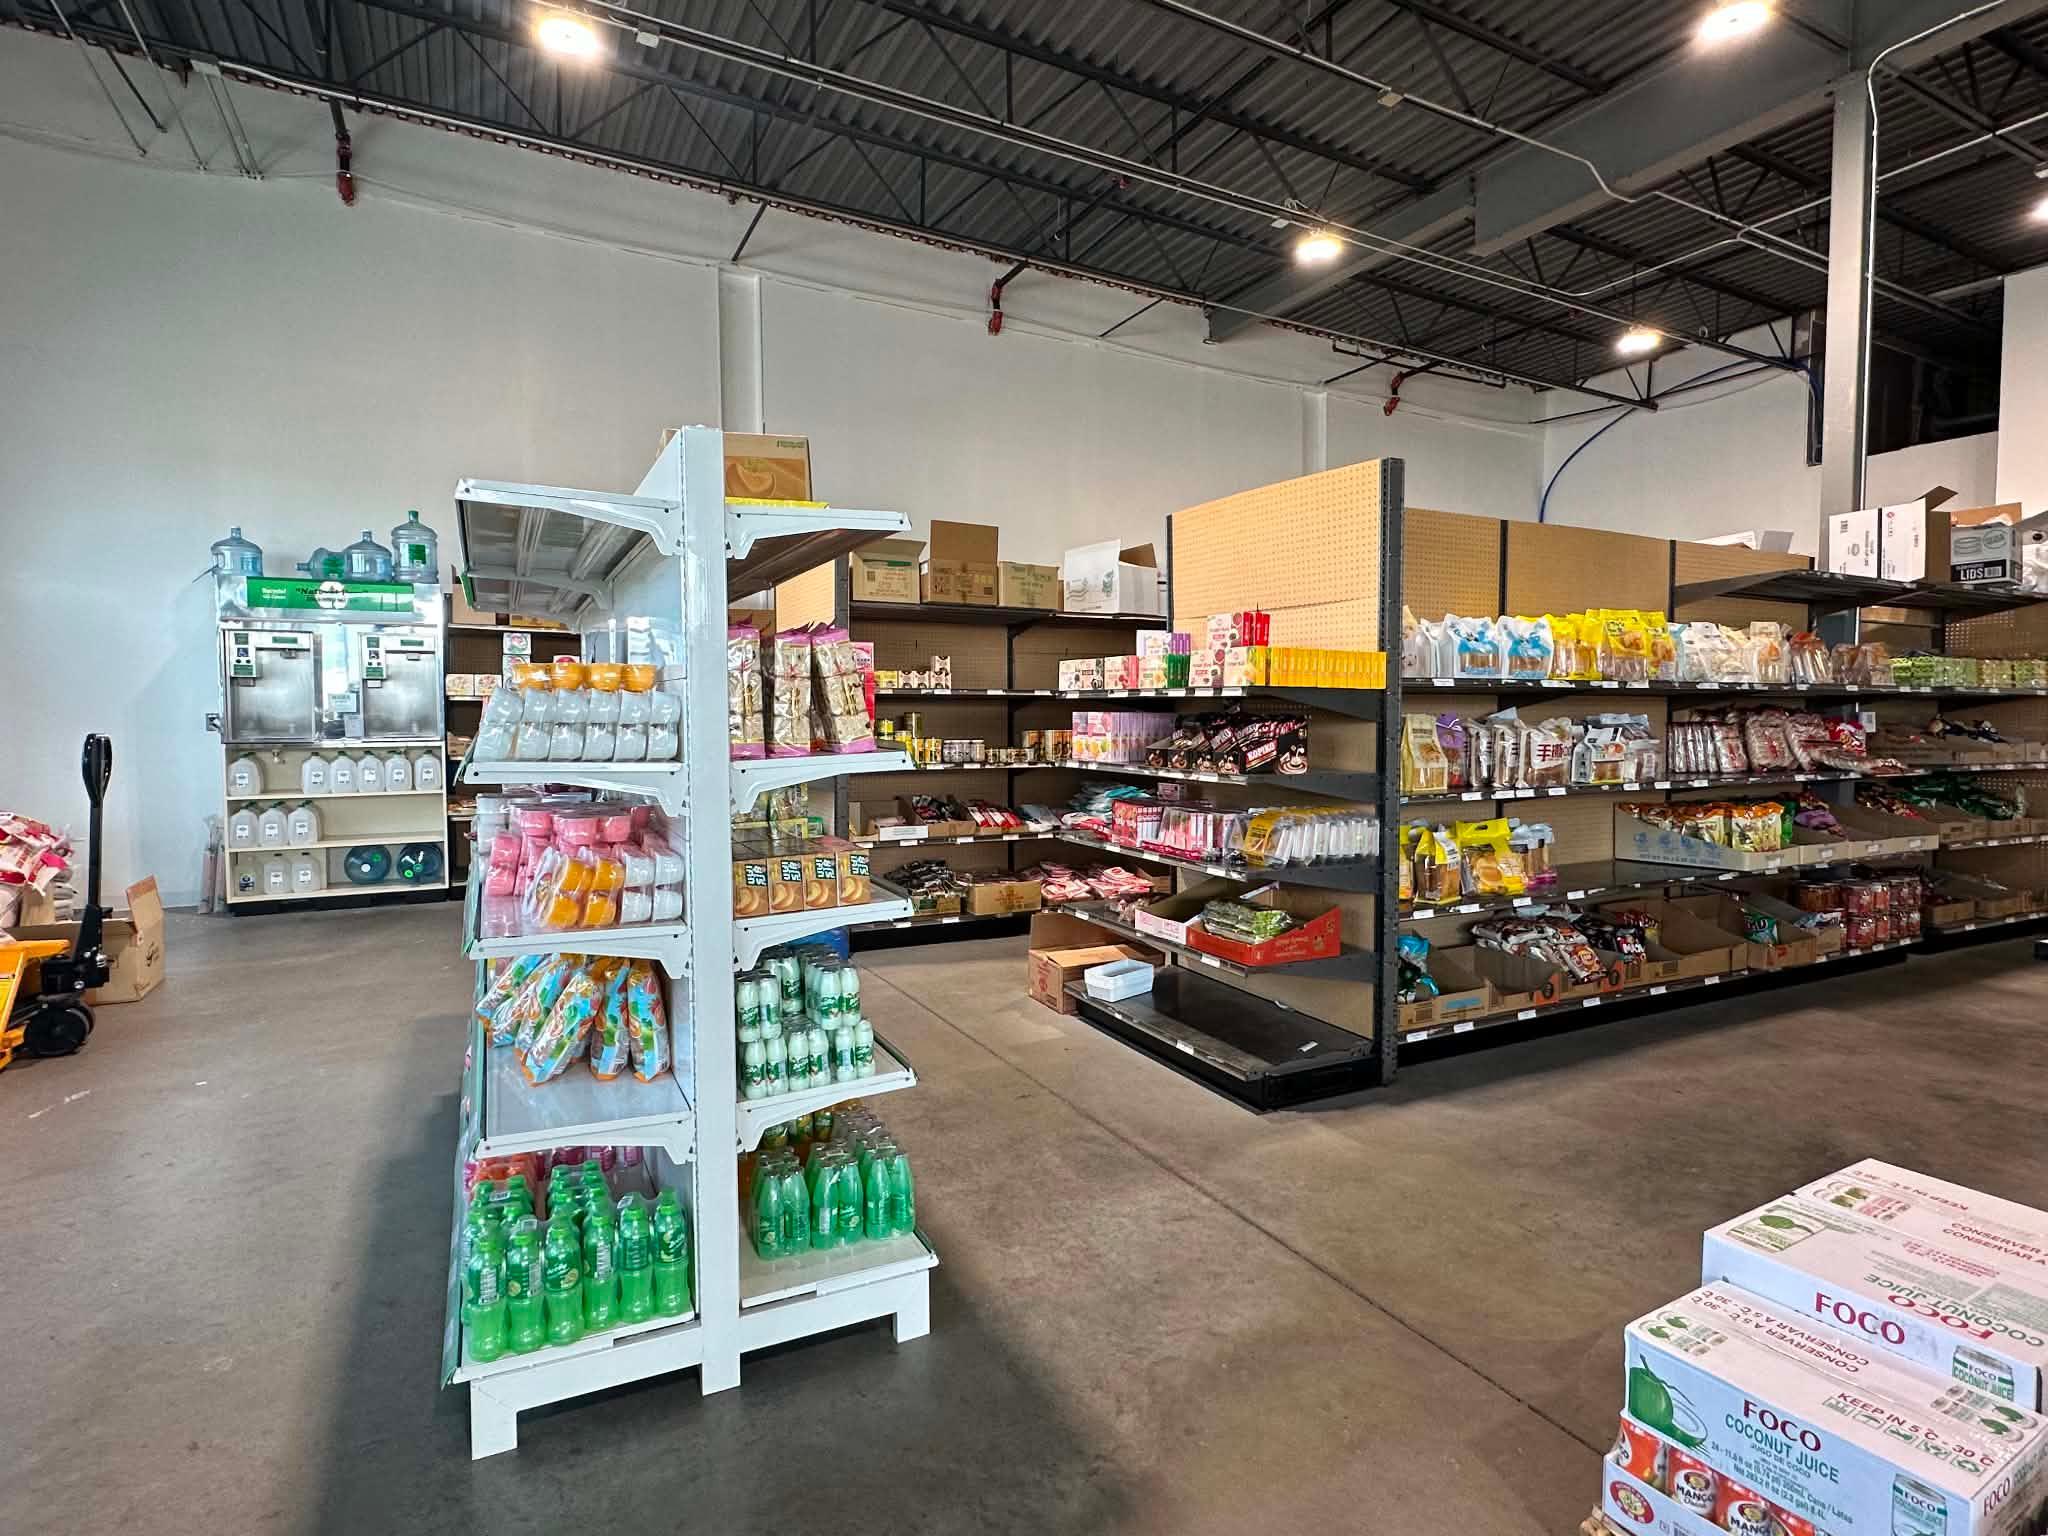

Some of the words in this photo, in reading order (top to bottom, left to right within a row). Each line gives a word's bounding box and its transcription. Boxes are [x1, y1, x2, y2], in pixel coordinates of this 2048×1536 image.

[1961, 568, 1984, 580] LIDS
[1943, 1228, 2033, 1261] CONSERVAR
[1951, 1222, 2041, 1254] CONSERVER
[1863, 1273, 1928, 1301] JUICE
[1814, 1292, 1905, 1345] FOCO
[1887, 1295, 1994, 1339] FOCO
[1930, 1299, 2045, 1347] COCONUT
[1765, 1328, 1859, 1373] CONSERVER
[1776, 1322, 1869, 1366] CONSERVAR
[1953, 1367, 1989, 1393] COCONUT
[1968, 1363, 1997, 1380] FOCO
[1743, 1399, 1821, 1452] FOCO
[1838, 1392, 1885, 1415] KEEP
[1886, 1414, 1906, 1427] IN
[1909, 1425, 1921, 1433] 5
[1952, 1444, 1976, 1458] 30
[1725, 1413, 1793, 1458] COCONUT
[1796, 1450, 1840, 1484] JUICE
[1751, 1445, 1772, 1458] JUGO
[1774, 1454, 1785, 1464] DE
[1787, 1461, 1811, 1479] COCO
[1902, 1490, 1936, 1512] FOCO
[1983, 1478, 2011, 1517] FOCO
